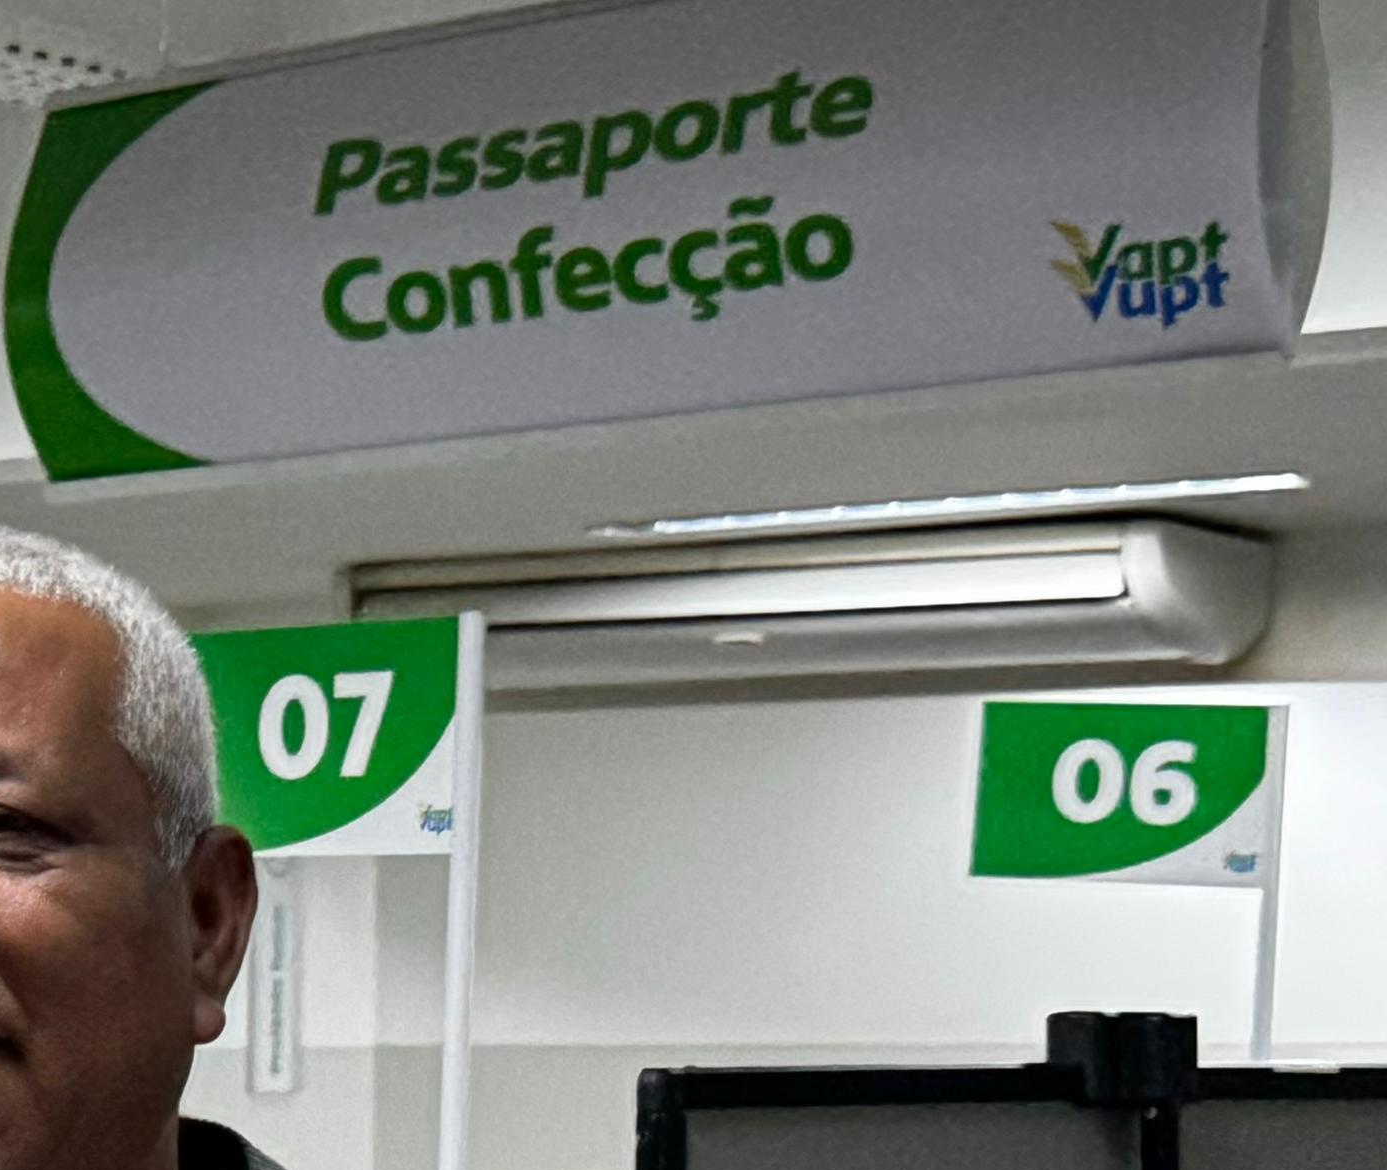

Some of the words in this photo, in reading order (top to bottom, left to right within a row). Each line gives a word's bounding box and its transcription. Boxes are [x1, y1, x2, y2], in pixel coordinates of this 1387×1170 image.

[314, 67, 873, 215] Passaporte
[322, 195, 853, 341] Confecção
[1051, 220, 1229, 284] Vapt
[1051, 260, 1230, 330] Vupt
[259, 670, 394, 780] 07
[1052, 738, 1198, 826] 06
